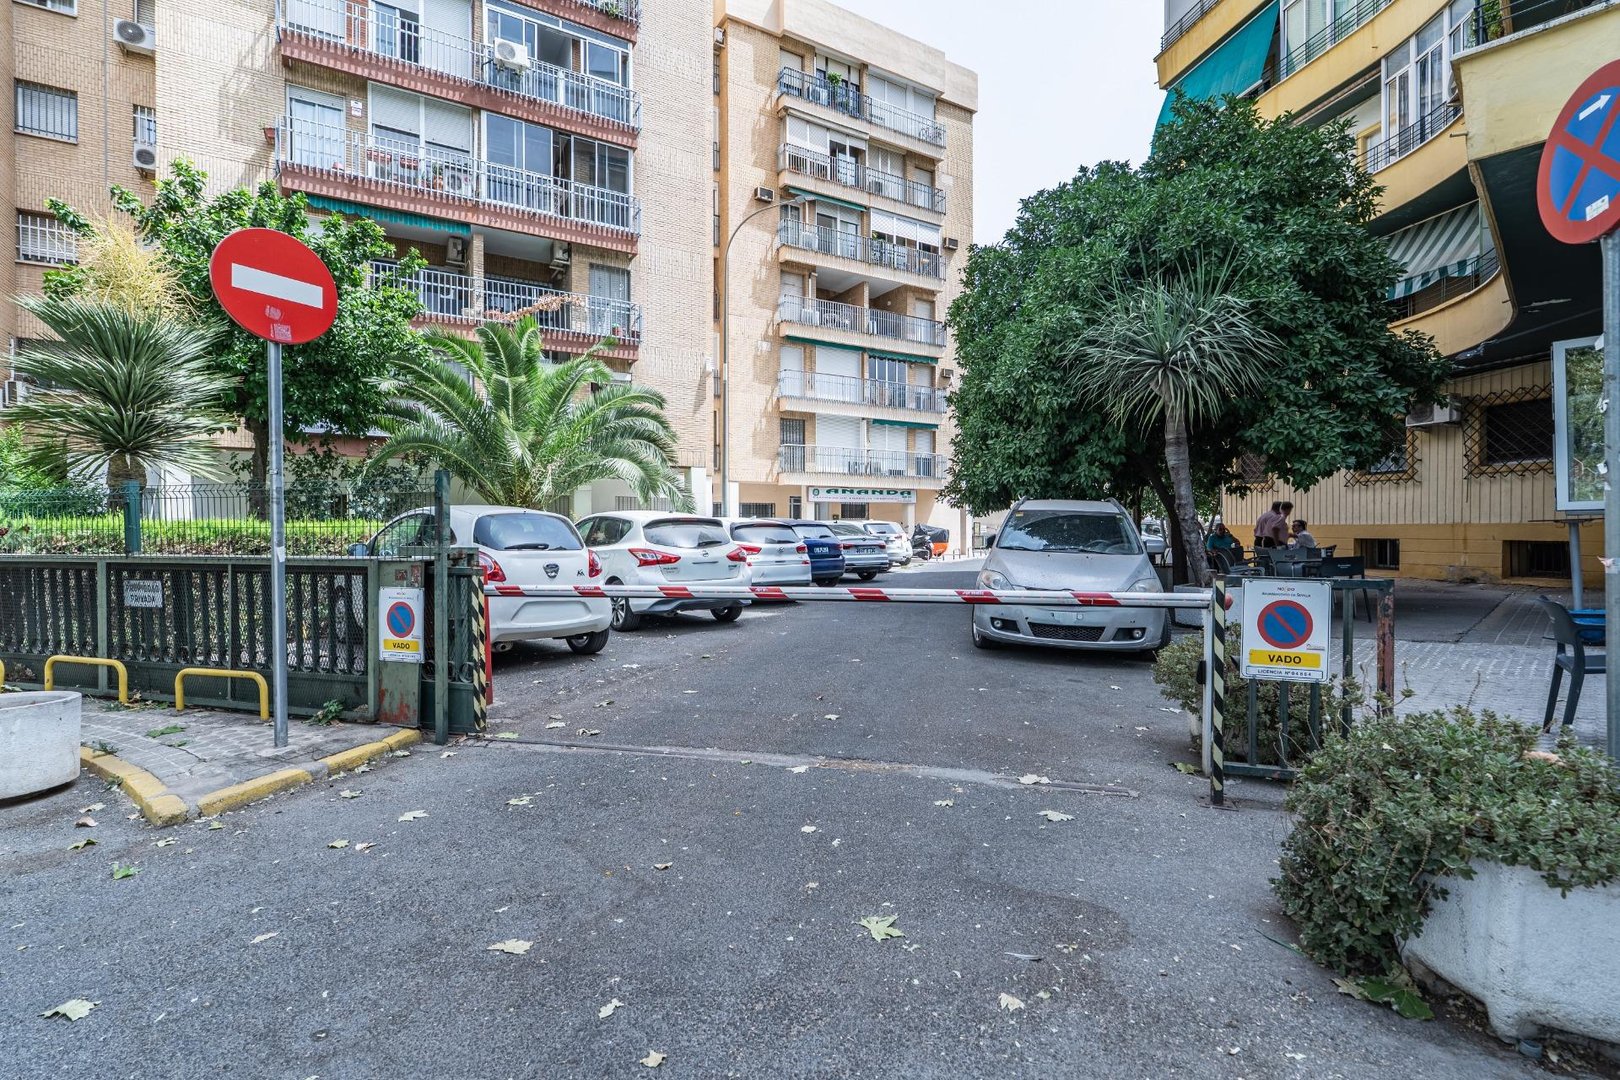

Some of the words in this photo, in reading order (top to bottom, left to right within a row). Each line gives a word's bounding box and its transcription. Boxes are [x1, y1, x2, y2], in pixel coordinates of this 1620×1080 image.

[826, 488, 912, 496] ANANDA
[392, 642, 411, 650] VADO
[1268, 654, 1302, 664] VADO
